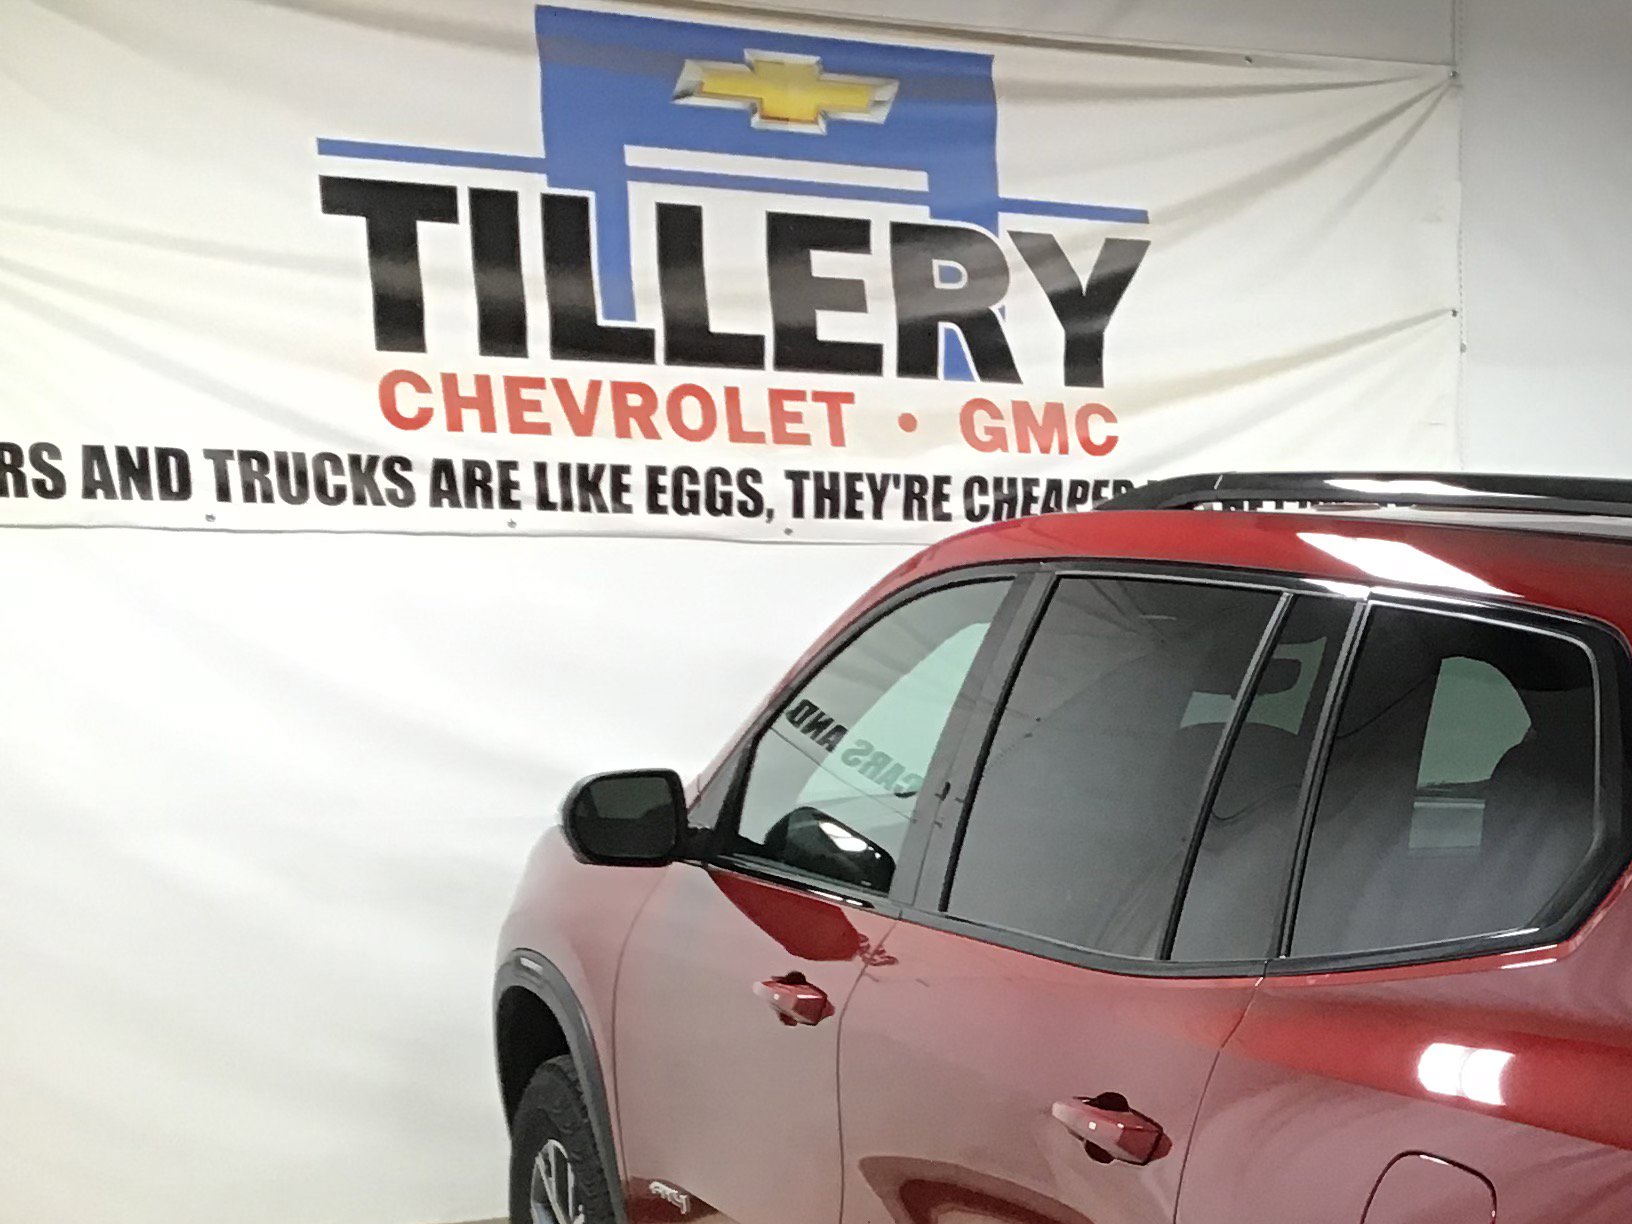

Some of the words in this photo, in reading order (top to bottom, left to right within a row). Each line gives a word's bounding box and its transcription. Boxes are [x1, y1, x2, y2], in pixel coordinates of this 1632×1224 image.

[319, 174, 1152, 389] TILLERY
[378, 369, 855, 447] CHEVROLET
[959, 397, 1120, 456] GMC
[81, 444, 192, 501] AND
[203, 448, 415, 507] TRUCKS
[429, 456, 521, 511] ARE
[536, 461, 634, 514] LIKE
[646, 464, 776, 524] EGGS,
[785, 469, 953, 523] THEY'RE
